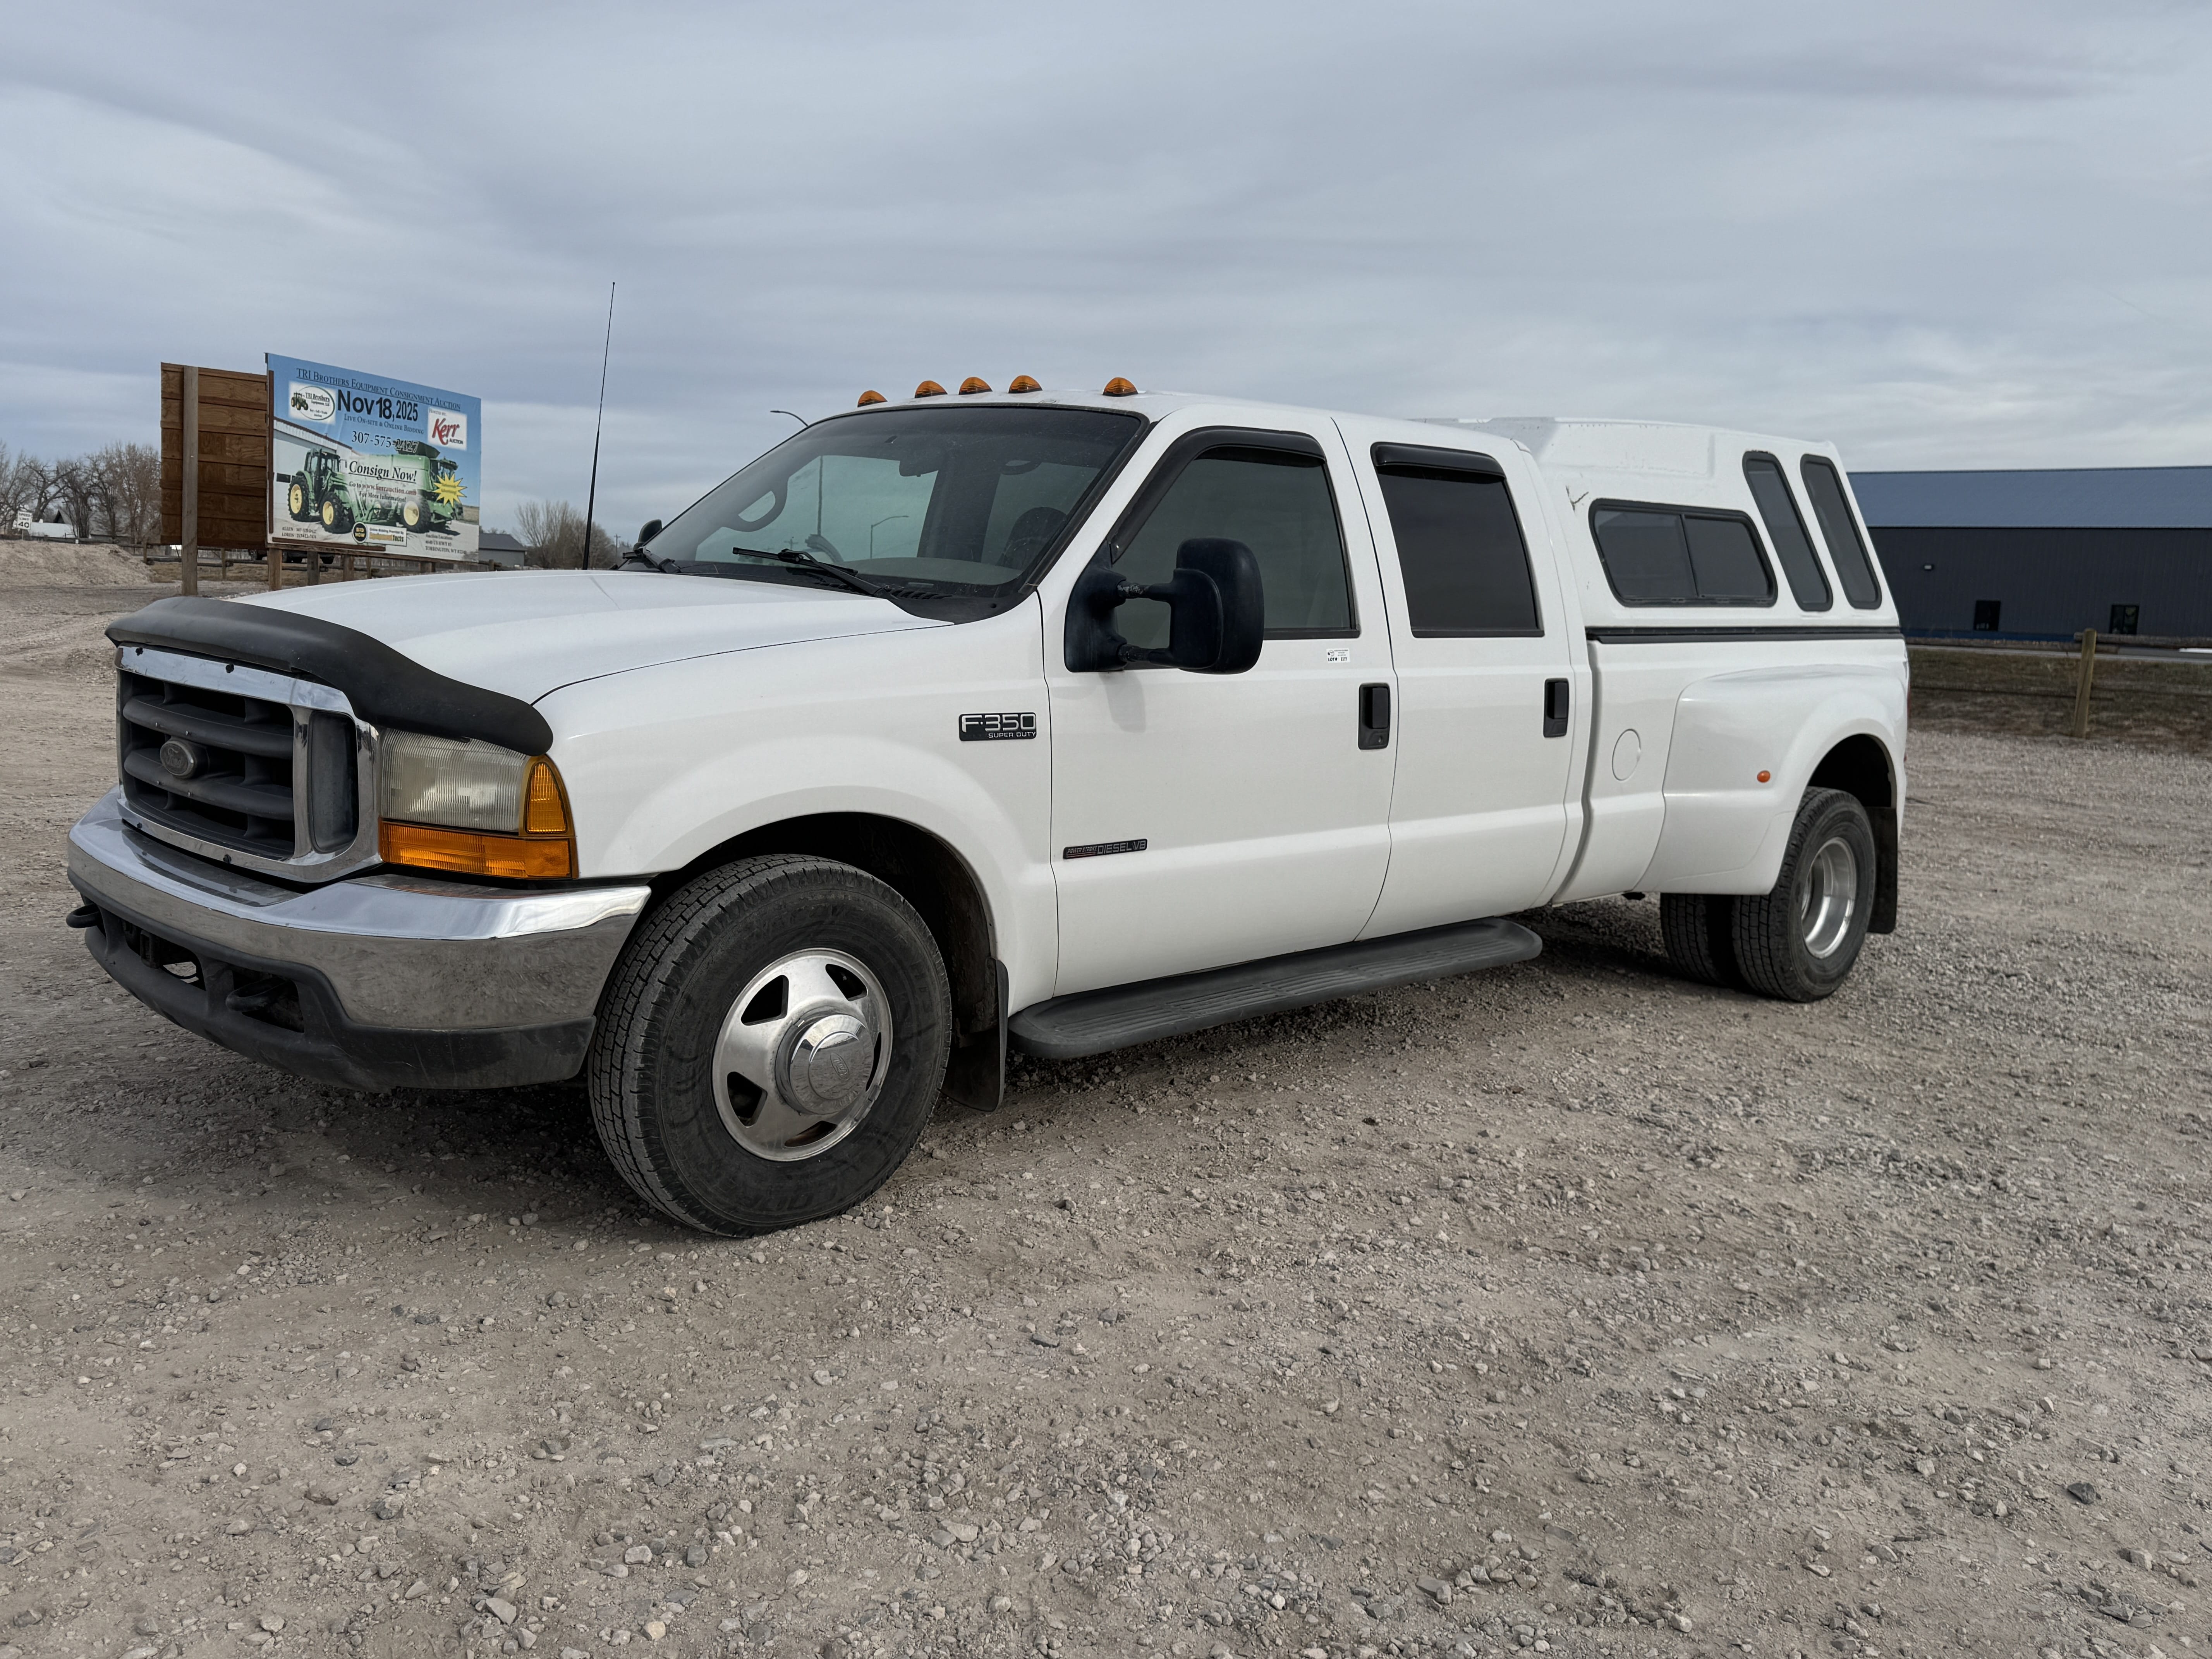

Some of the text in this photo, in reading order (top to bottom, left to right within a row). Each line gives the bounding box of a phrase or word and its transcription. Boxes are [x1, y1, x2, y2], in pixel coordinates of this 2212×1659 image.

[297, 368, 460, 409] TRI BROTHERS EQUIPMENT CONSIGNMENT AUCTION
[338, 389, 375, 415] Nov
[357, 416, 378, 426] ON-SITE
[384, 421, 402, 431] ONLINE
[404, 425, 424, 434] BIDDING
[432, 418, 460, 445] Kerr
[352, 431, 419, 453] 307-575-2427
[349, 461, 417, 482] Consign Now!
[362, 484, 417, 495] www.kerrauction.com
[380, 494, 406, 502] Information!
[1097, 842, 1132, 855] DIESEL
[1133, 840, 1146, 850] V8
